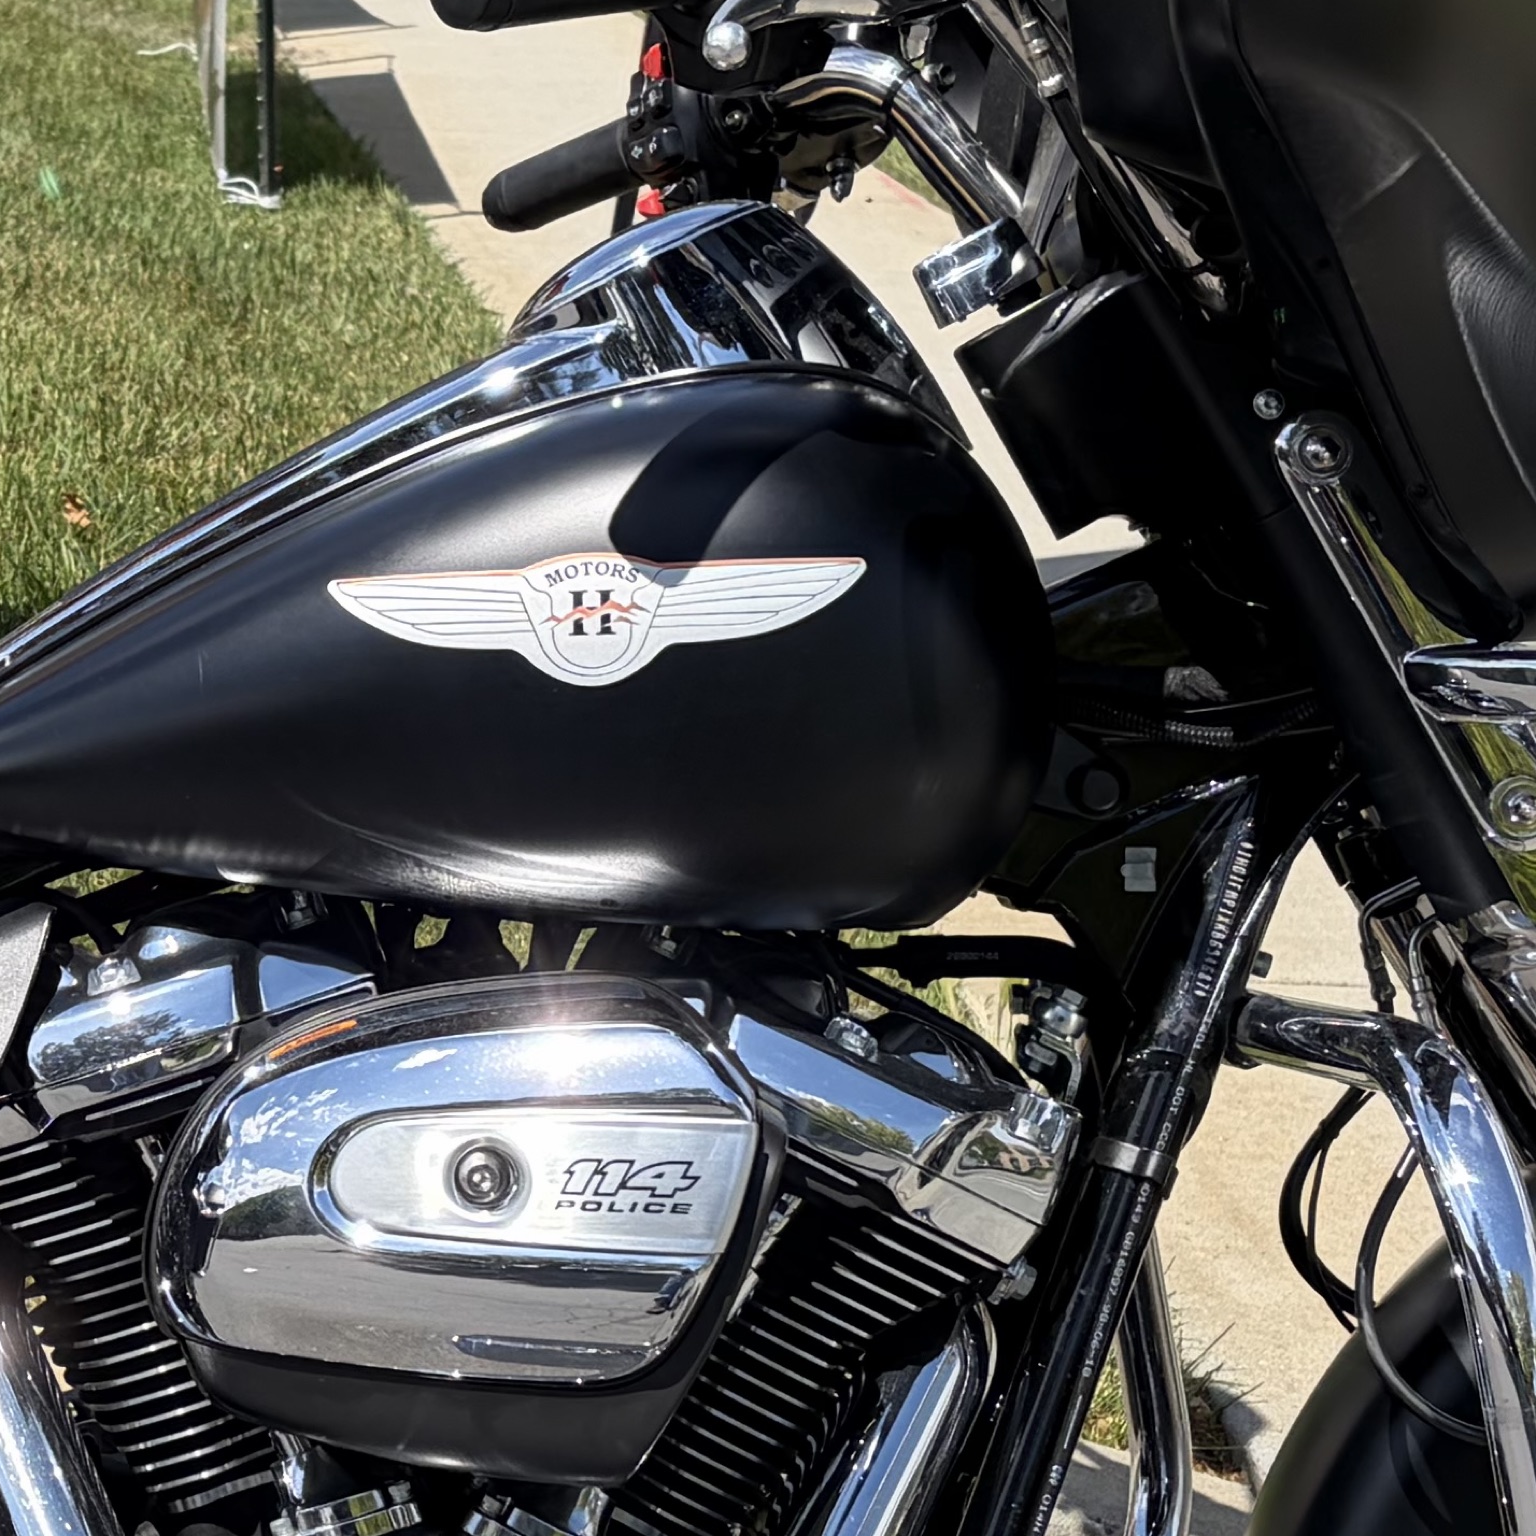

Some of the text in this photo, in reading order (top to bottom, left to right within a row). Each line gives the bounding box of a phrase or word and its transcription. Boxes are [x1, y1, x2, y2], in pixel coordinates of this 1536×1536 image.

[545, 560, 642, 588] MOTORS
[566, 588, 617, 637] H
[560, 1158, 702, 1199] 114
[555, 1199, 693, 1215] POLICE
